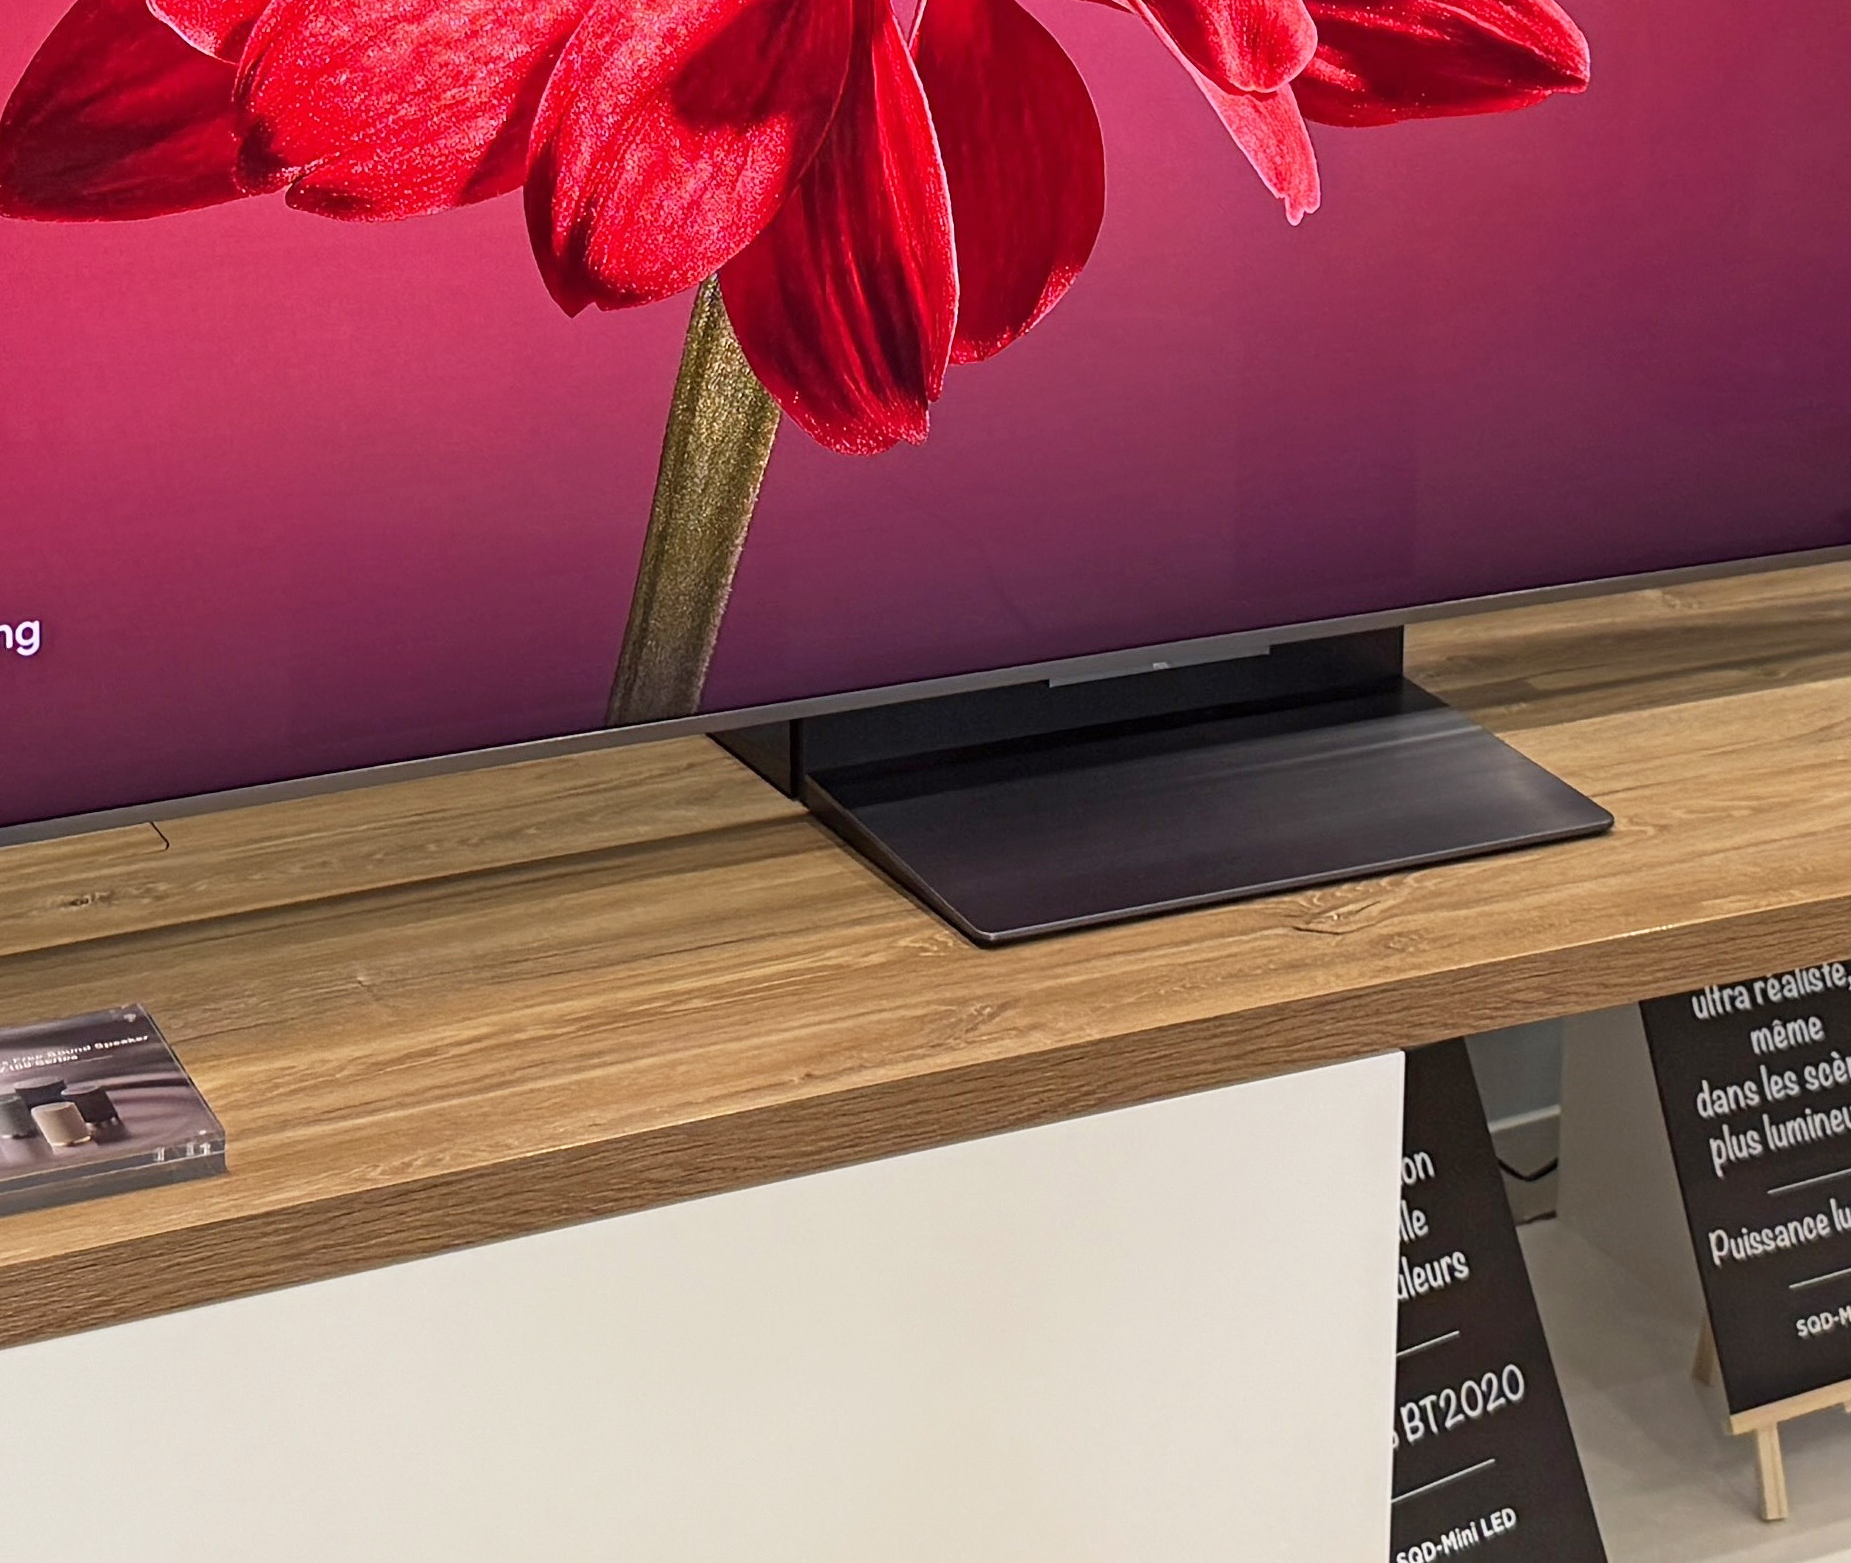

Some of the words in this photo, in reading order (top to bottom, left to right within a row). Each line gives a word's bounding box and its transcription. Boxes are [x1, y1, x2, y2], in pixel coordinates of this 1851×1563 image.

[1750, 1015, 1825, 1056] même
[1697, 1079, 1760, 1119] dans
[1759, 1064, 1799, 1102] les
[1709, 1123, 1764, 1179] plus
[1708, 1212, 1832, 1267] Puissance
[1400, 1364, 1525, 1445] BT2020
[1395, 1520, 1480, 1563] SQD-Mini
[1479, 1507, 1517, 1537] LED
